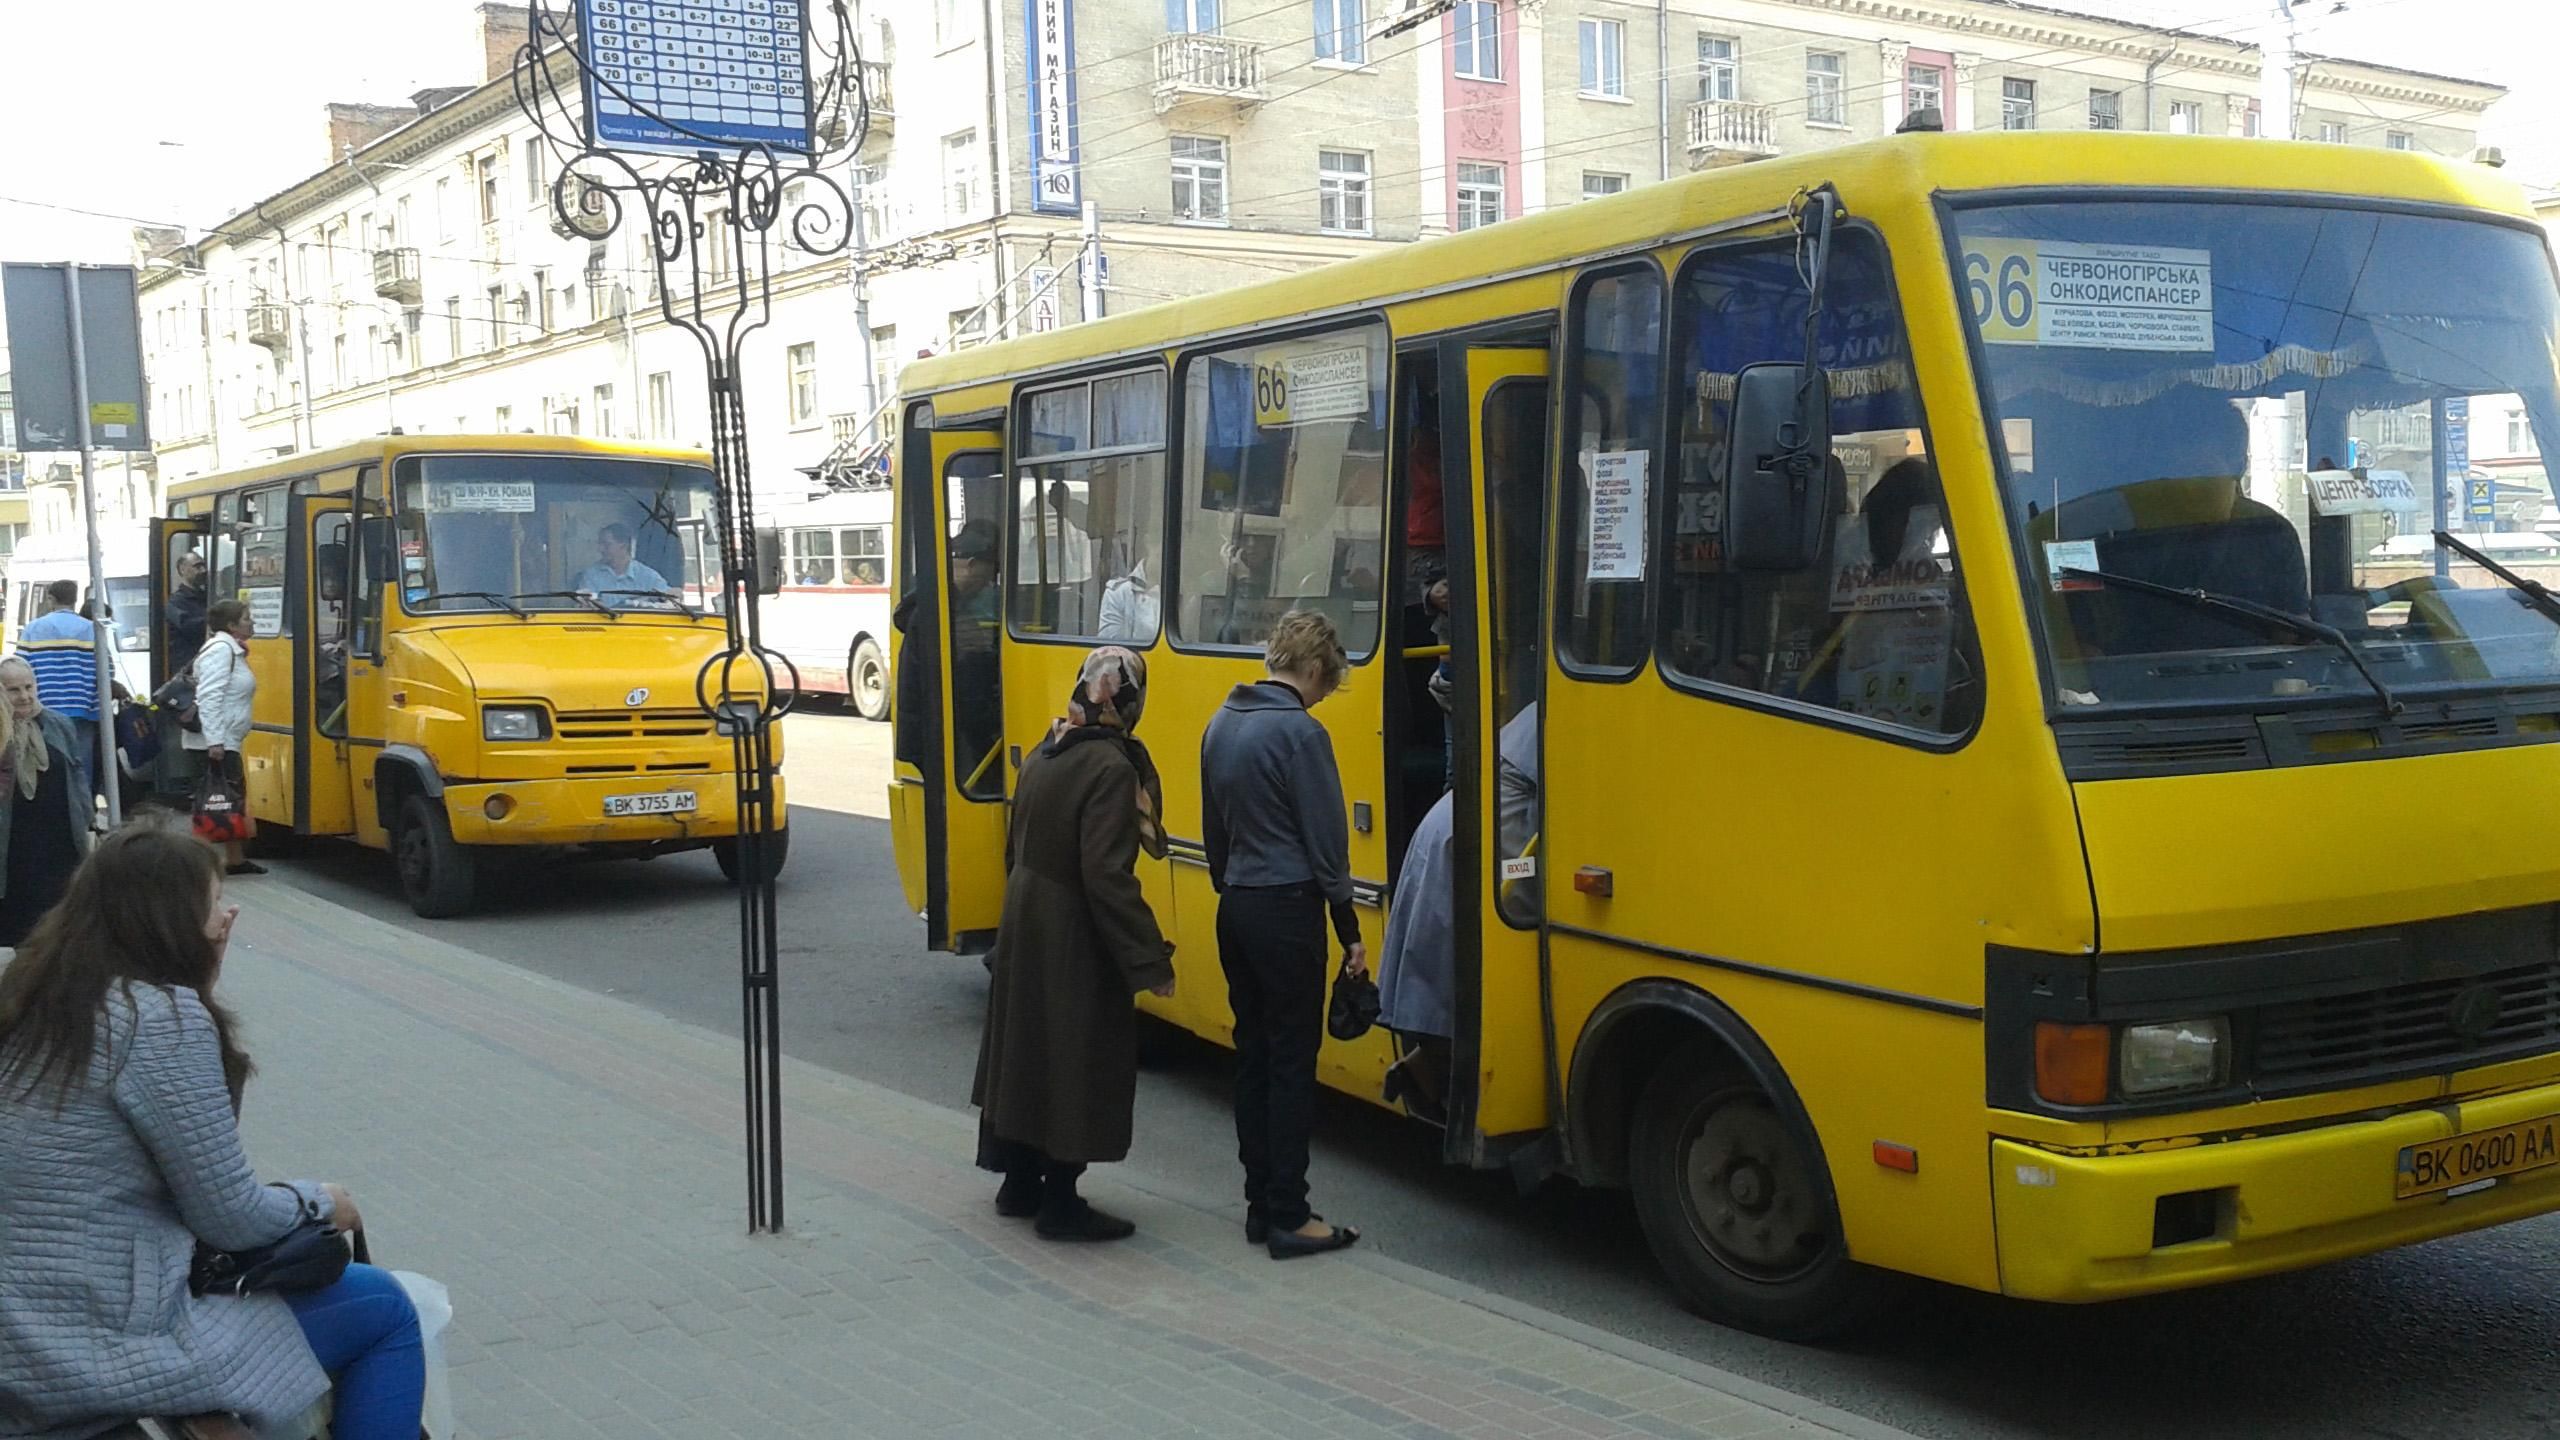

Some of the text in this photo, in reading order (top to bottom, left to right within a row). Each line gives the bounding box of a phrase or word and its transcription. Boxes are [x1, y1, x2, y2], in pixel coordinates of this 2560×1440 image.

[598, 2, 616, 12] 65
[600, 18, 616, 29] 66
[602, 35, 618, 46] 67
[602, 52, 620, 63] 69
[604, 69, 620, 80] 70
[1046, 54, 1060, 152] МАГАЗИН
[2048, 260, 2200, 285] ЧЕРВОНОГІРСЬКА
[1964, 252, 2032, 328] 66
[2050, 282, 2200, 306] ОНКОДИСПАНСЕР
[1258, 360, 1286, 412] 66
[2315, 480, 2416, 505] ЦЕНТР-БОЯРКА
[614, 794, 695, 812] BK 3755 AM
[1507, 862, 1529, 873] ВХІД
[2416, 1124, 2555, 1186] BK 0600 AA
